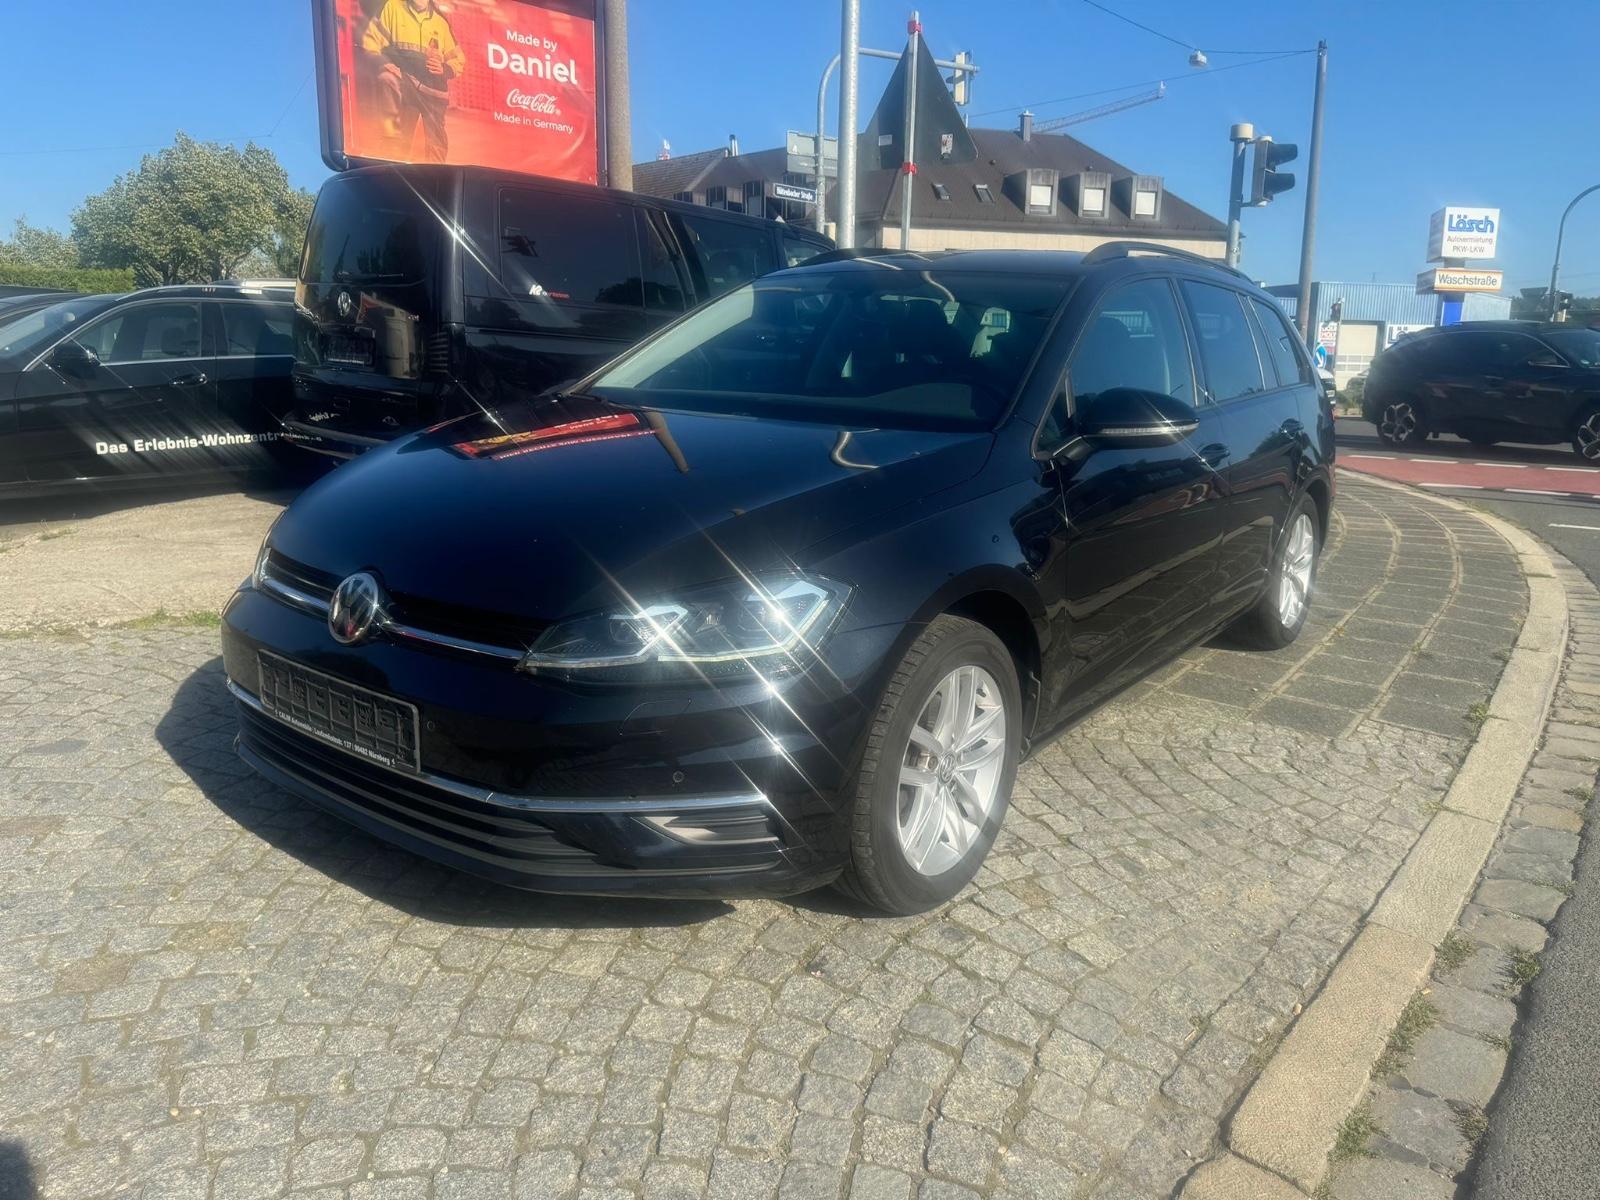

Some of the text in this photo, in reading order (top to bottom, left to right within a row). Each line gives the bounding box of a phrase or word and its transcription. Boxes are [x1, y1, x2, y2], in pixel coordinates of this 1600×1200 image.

[506, 29, 558, 52] Made by
[487, 42, 578, 85] Daniel
[506, 88, 558, 115] Coca-Cola
[494, 111, 574, 135] Made in Germany
[1448, 214, 1494, 233] Lösch
[1446, 235, 1494, 245] Autovermietung
[1452, 245, 1485, 253] PKW-LKW
[1438, 274, 1498, 286] Waschstraße
[95, 441, 128, 455] Das
